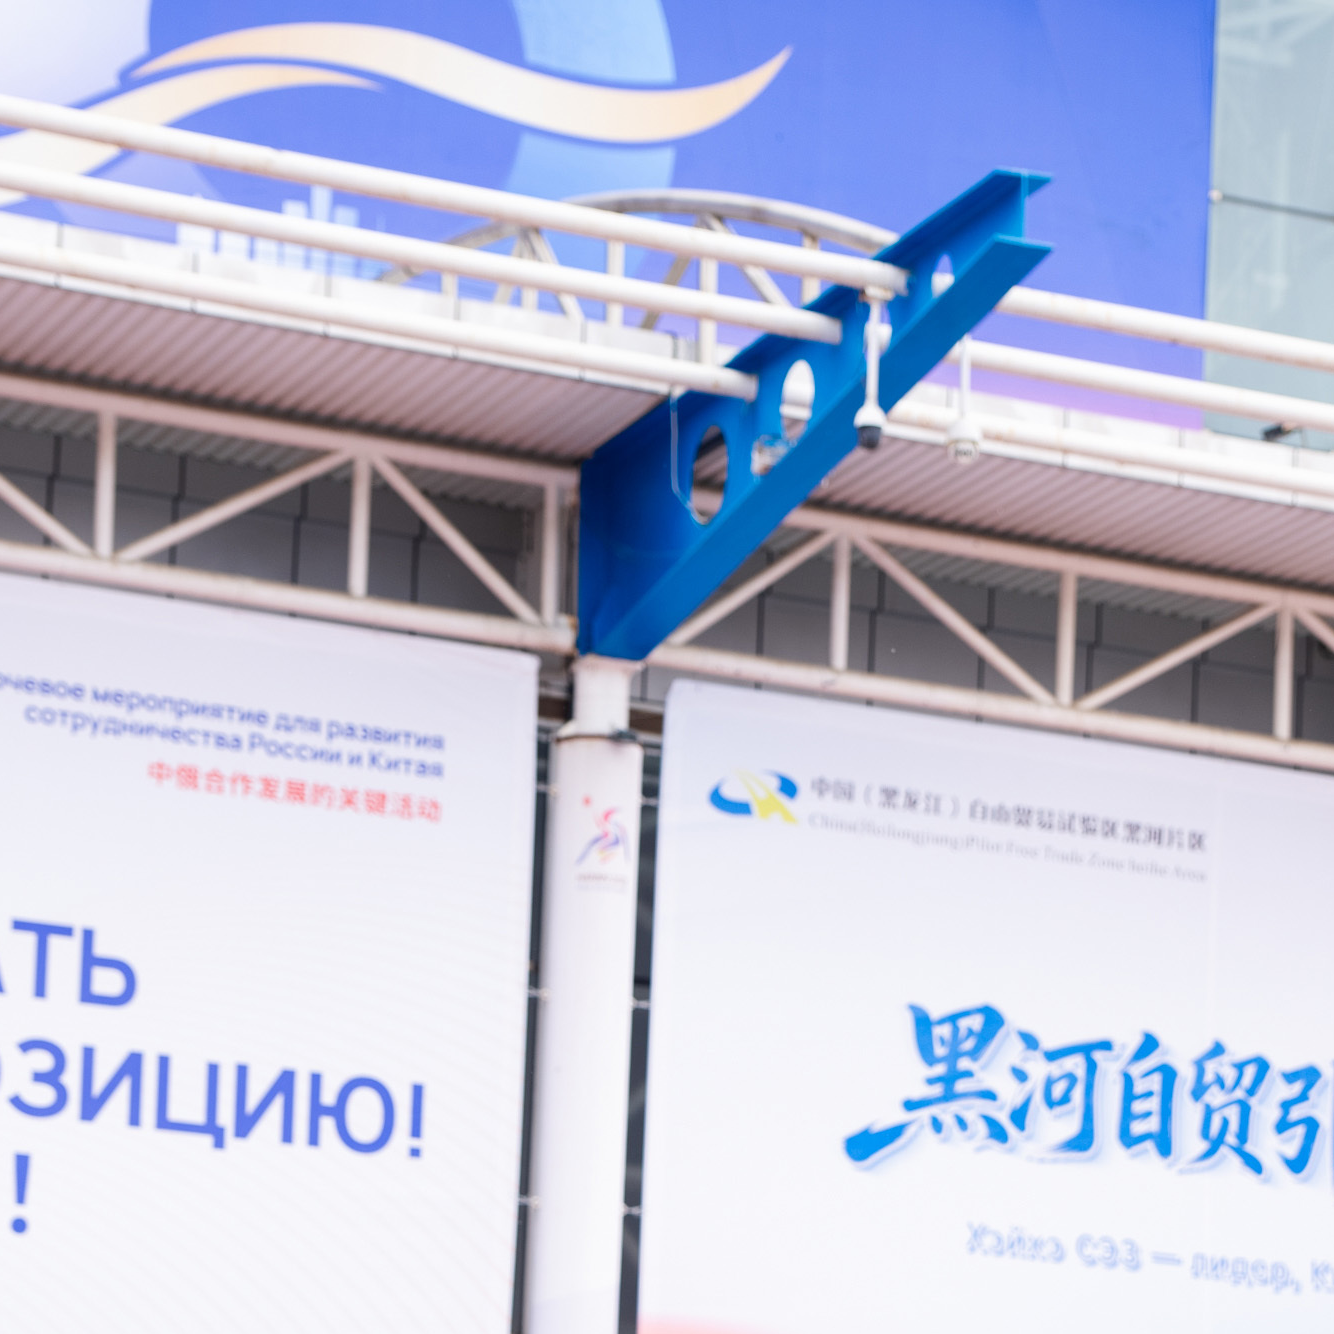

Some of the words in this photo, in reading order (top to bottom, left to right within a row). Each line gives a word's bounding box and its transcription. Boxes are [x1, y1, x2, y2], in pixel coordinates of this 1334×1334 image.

[24, 702, 244, 755] сотрудничества
[248, 730, 343, 767] России
[348, 750, 364, 769] и
[368, 748, 446, 781] Китая
[91, 680, 269, 728] мероприятие
[274, 711, 322, 736] для
[327, 718, 446, 753] развития
[1075, 1232, 1143, 1272] СЭЗ
[1190, 1250, 1302, 1295] лидер,
